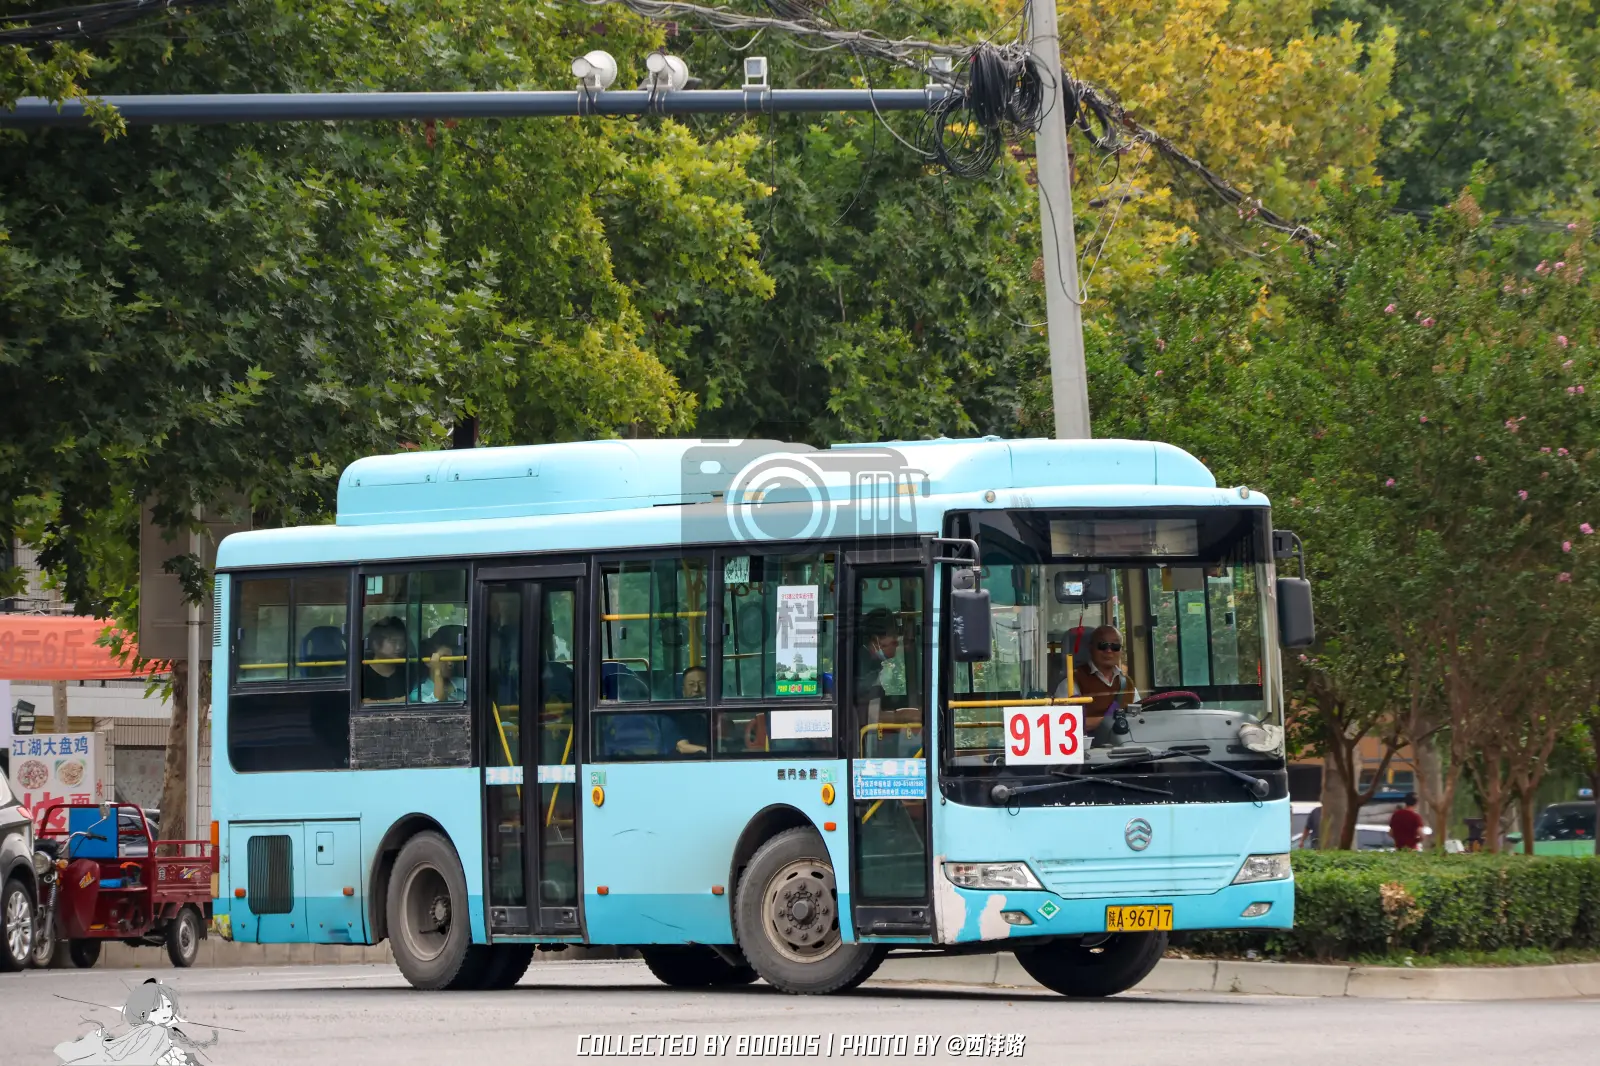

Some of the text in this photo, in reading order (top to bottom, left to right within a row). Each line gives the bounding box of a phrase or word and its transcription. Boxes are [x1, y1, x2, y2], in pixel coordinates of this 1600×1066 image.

[12, 736, 89, 756] 江湖大盘鸡
[1009, 712, 1079, 757] 913
